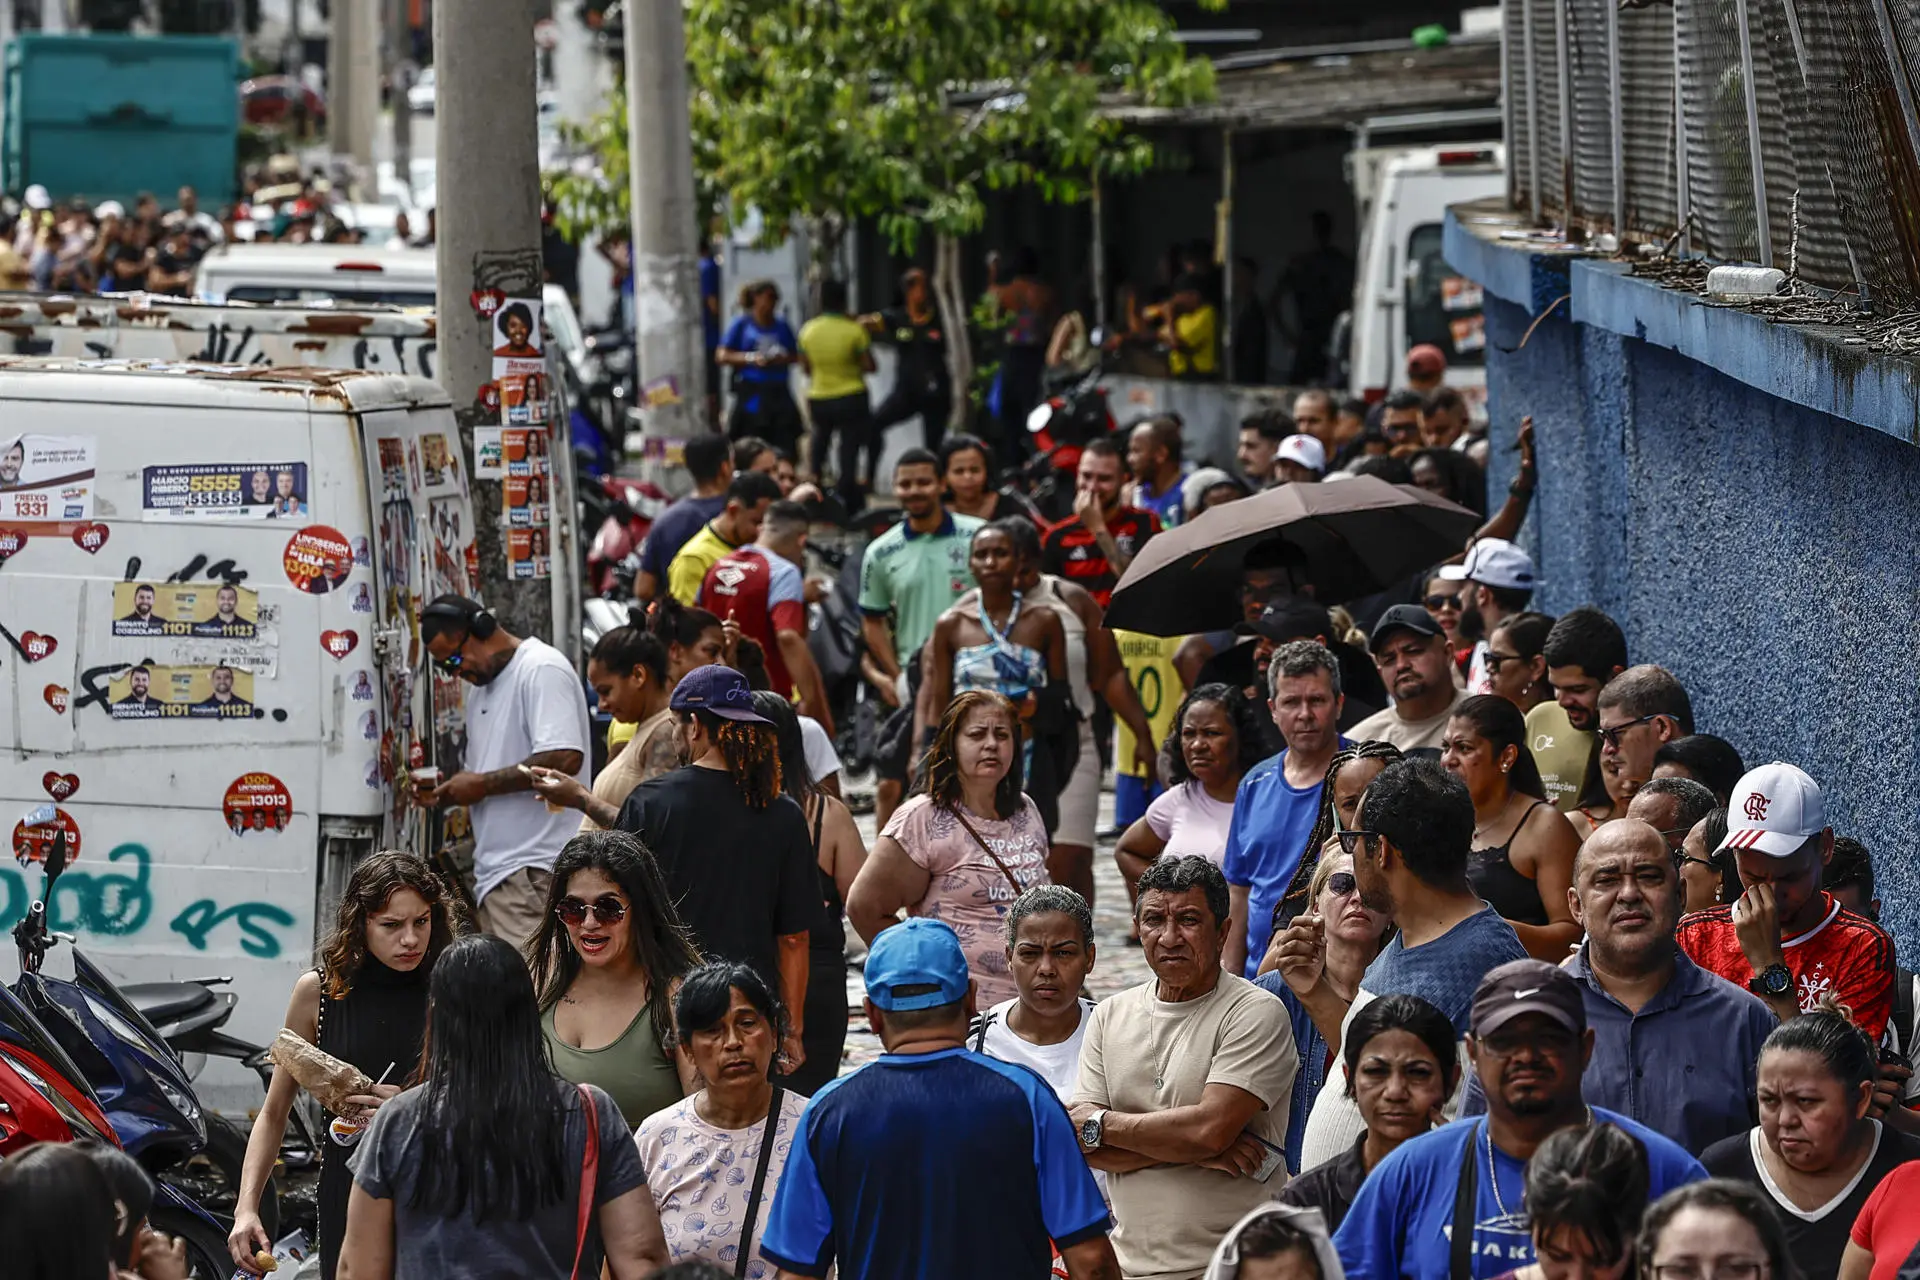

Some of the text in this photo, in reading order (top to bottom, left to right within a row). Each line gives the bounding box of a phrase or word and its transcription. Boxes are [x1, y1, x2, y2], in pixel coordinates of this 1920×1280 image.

[190, 474, 242, 492] 5555
[15, 494, 49, 502] FREIXO
[189, 492, 242, 506] 55555
[15, 502, 48, 516] 1331
[295, 533, 350, 554] LINDBERGH
[298, 553, 324, 567] LULA
[285, 559, 321, 578] 1300
[162, 622, 192, 635] 1101
[221, 624, 254, 636] 11123
[159, 704, 189, 716] 1101
[218, 705, 251, 717] 11123
[244, 776, 270, 785] 1300
[251, 794, 287, 806] 13013
